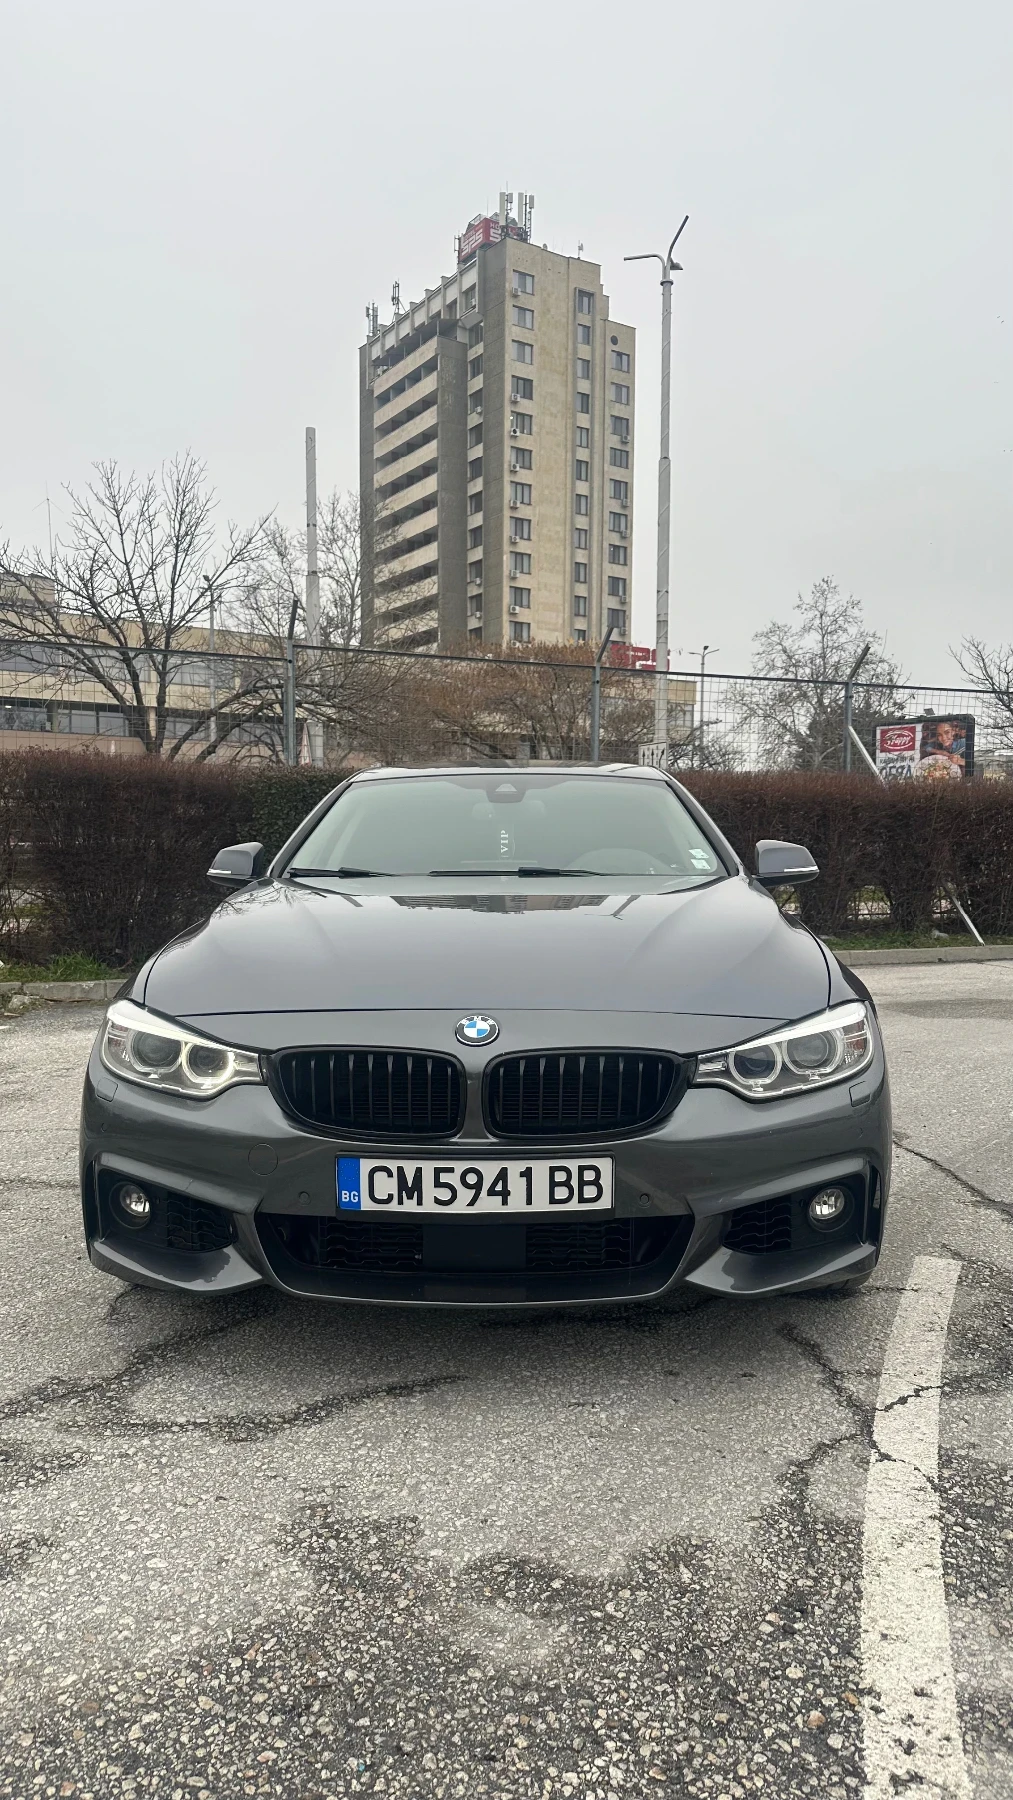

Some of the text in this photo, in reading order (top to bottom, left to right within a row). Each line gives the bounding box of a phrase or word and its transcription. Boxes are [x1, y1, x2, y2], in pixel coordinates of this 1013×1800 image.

[461, 228, 483, 256] SPS
[500, 829, 509, 854] VIP
[460, 1015, 495, 1025] BMW
[341, 1190, 359, 1203] BG
[367, 1164, 604, 1207] CM 5941 BB
